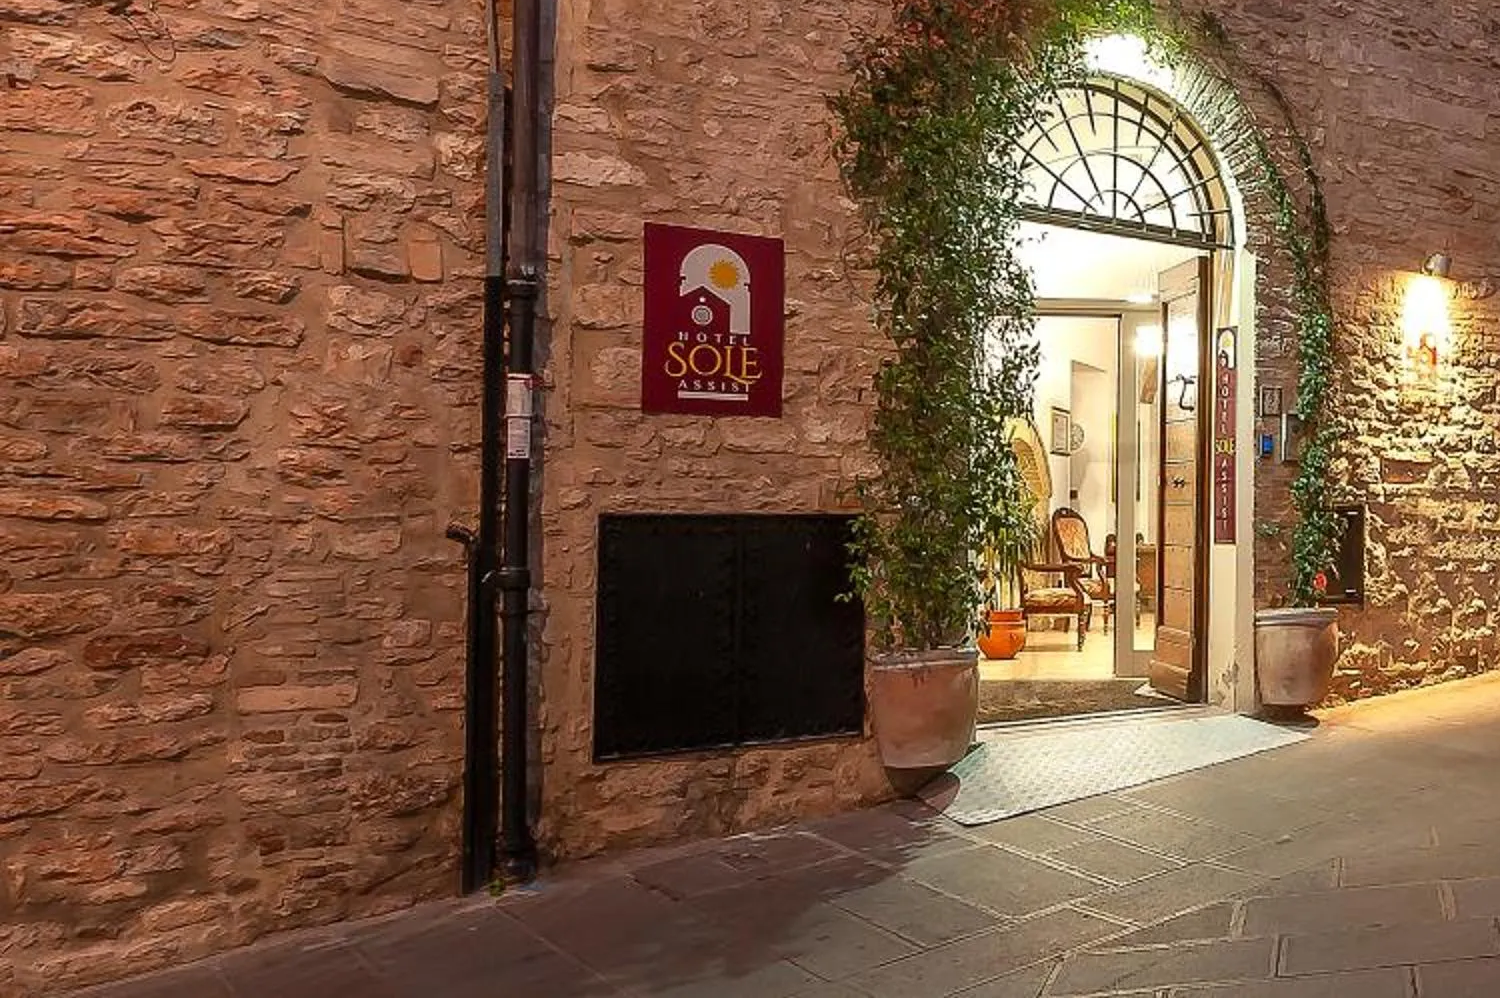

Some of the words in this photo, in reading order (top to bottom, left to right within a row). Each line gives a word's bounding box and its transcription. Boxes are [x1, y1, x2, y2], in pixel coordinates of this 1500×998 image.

[679, 332, 750, 346] HOTEL
[664, 341, 762, 385] SOLE
[679, 379, 750, 392] ASSIST
[1220, 371, 1230, 435] HOTEL
[1215, 437, 1236, 455] SOLE
[1220, 458, 1229, 531] ASSIST
